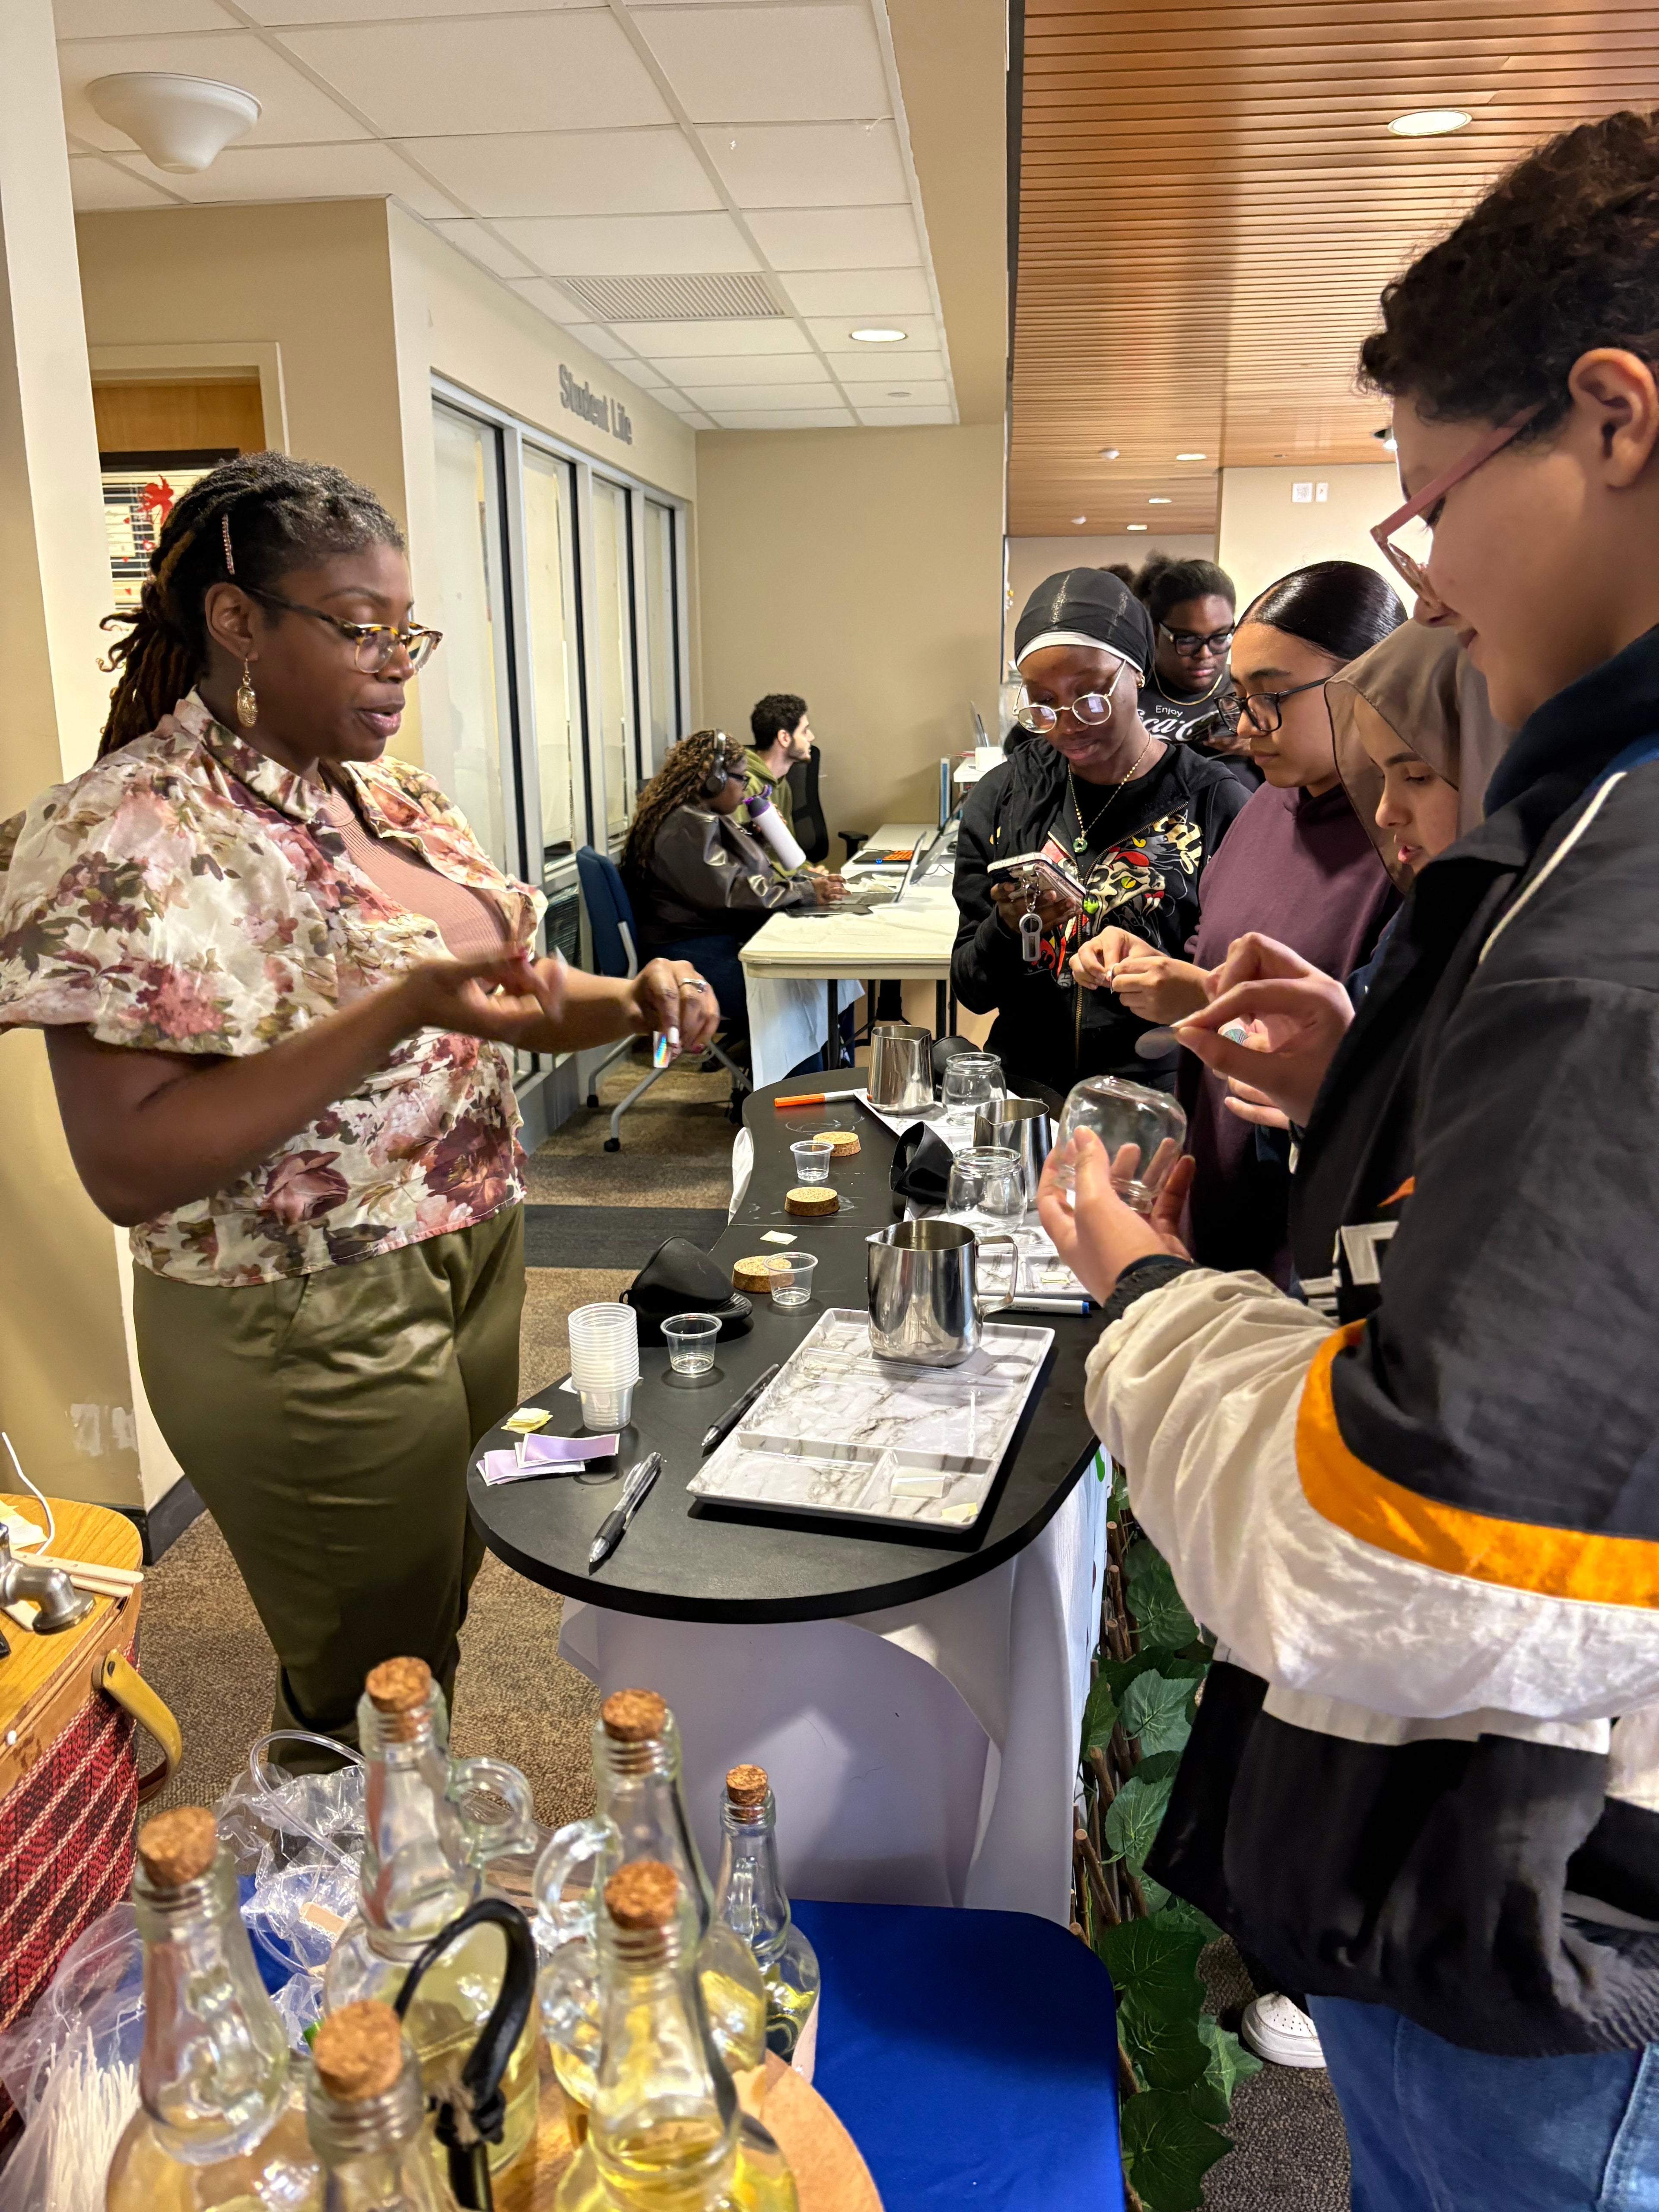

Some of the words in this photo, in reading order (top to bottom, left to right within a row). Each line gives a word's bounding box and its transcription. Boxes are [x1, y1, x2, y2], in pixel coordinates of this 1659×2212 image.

[559, 364, 610, 432] Student
[610, 398, 632, 445] Life
[1156, 705, 1183, 717] Enjoy
